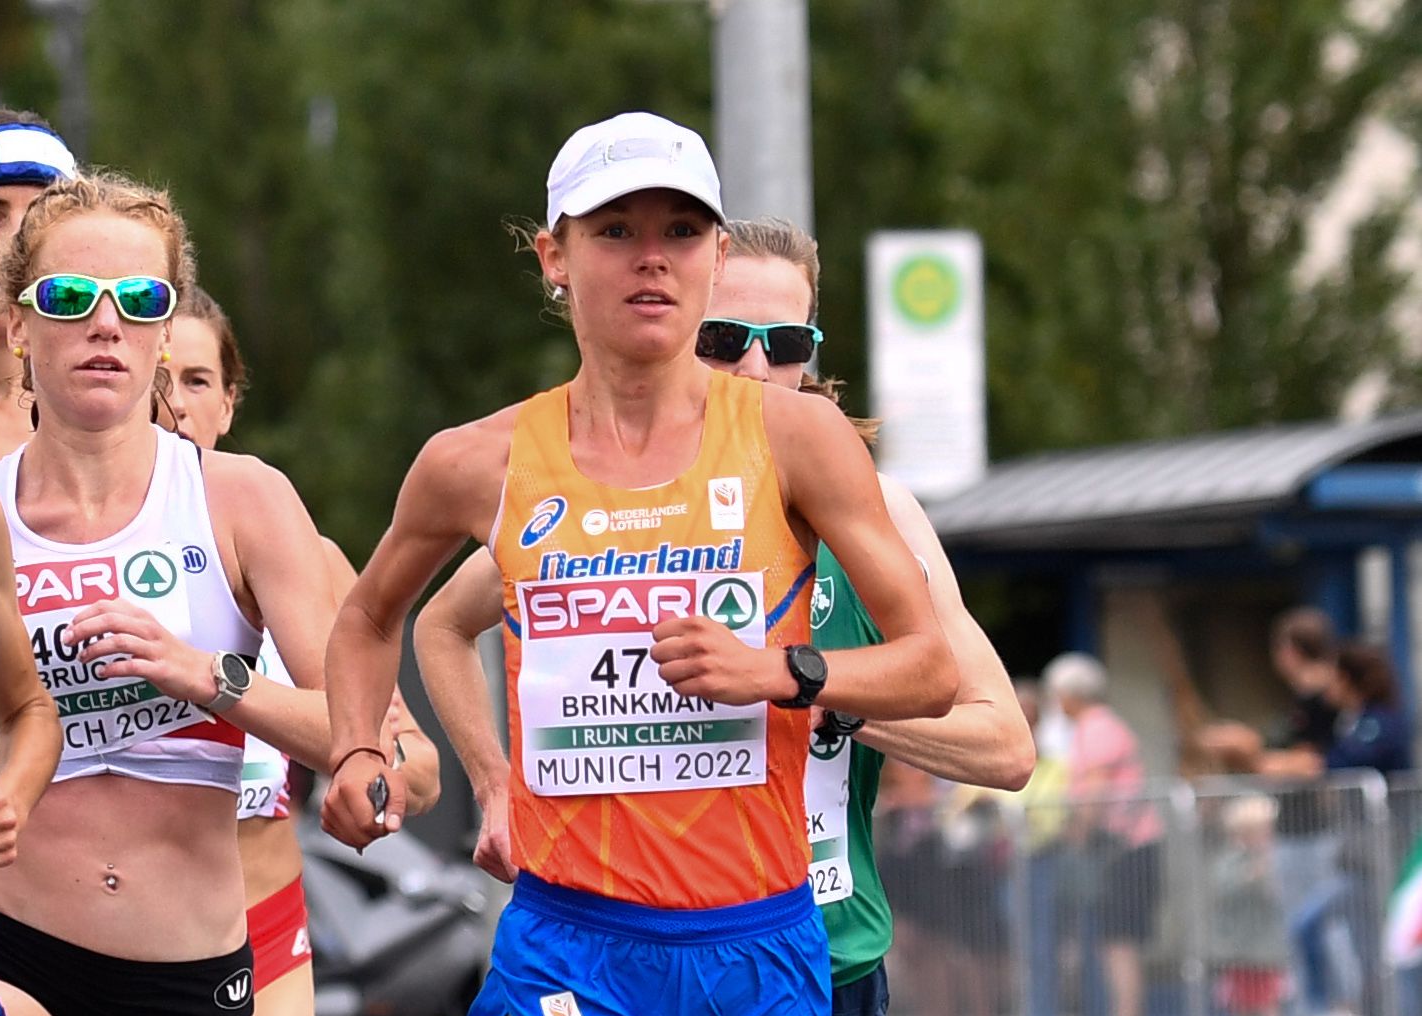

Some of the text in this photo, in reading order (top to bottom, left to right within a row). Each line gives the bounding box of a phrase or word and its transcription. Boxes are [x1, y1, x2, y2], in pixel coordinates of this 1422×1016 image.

[610, 504, 688, 520] NEDERLANDSE
[610, 517, 662, 532] LOTERIJ
[529, 586, 691, 632] SPAR
[31, 623, 104, 666] 40
[591, 648, 654, 689] 47
[116, 699, 192, 740] 2022
[562, 692, 715, 718] BRINKMAN
[572, 729, 577, 746] I
[584, 728, 628, 746] RUN
[538, 749, 751, 786] MUNICH 2022
